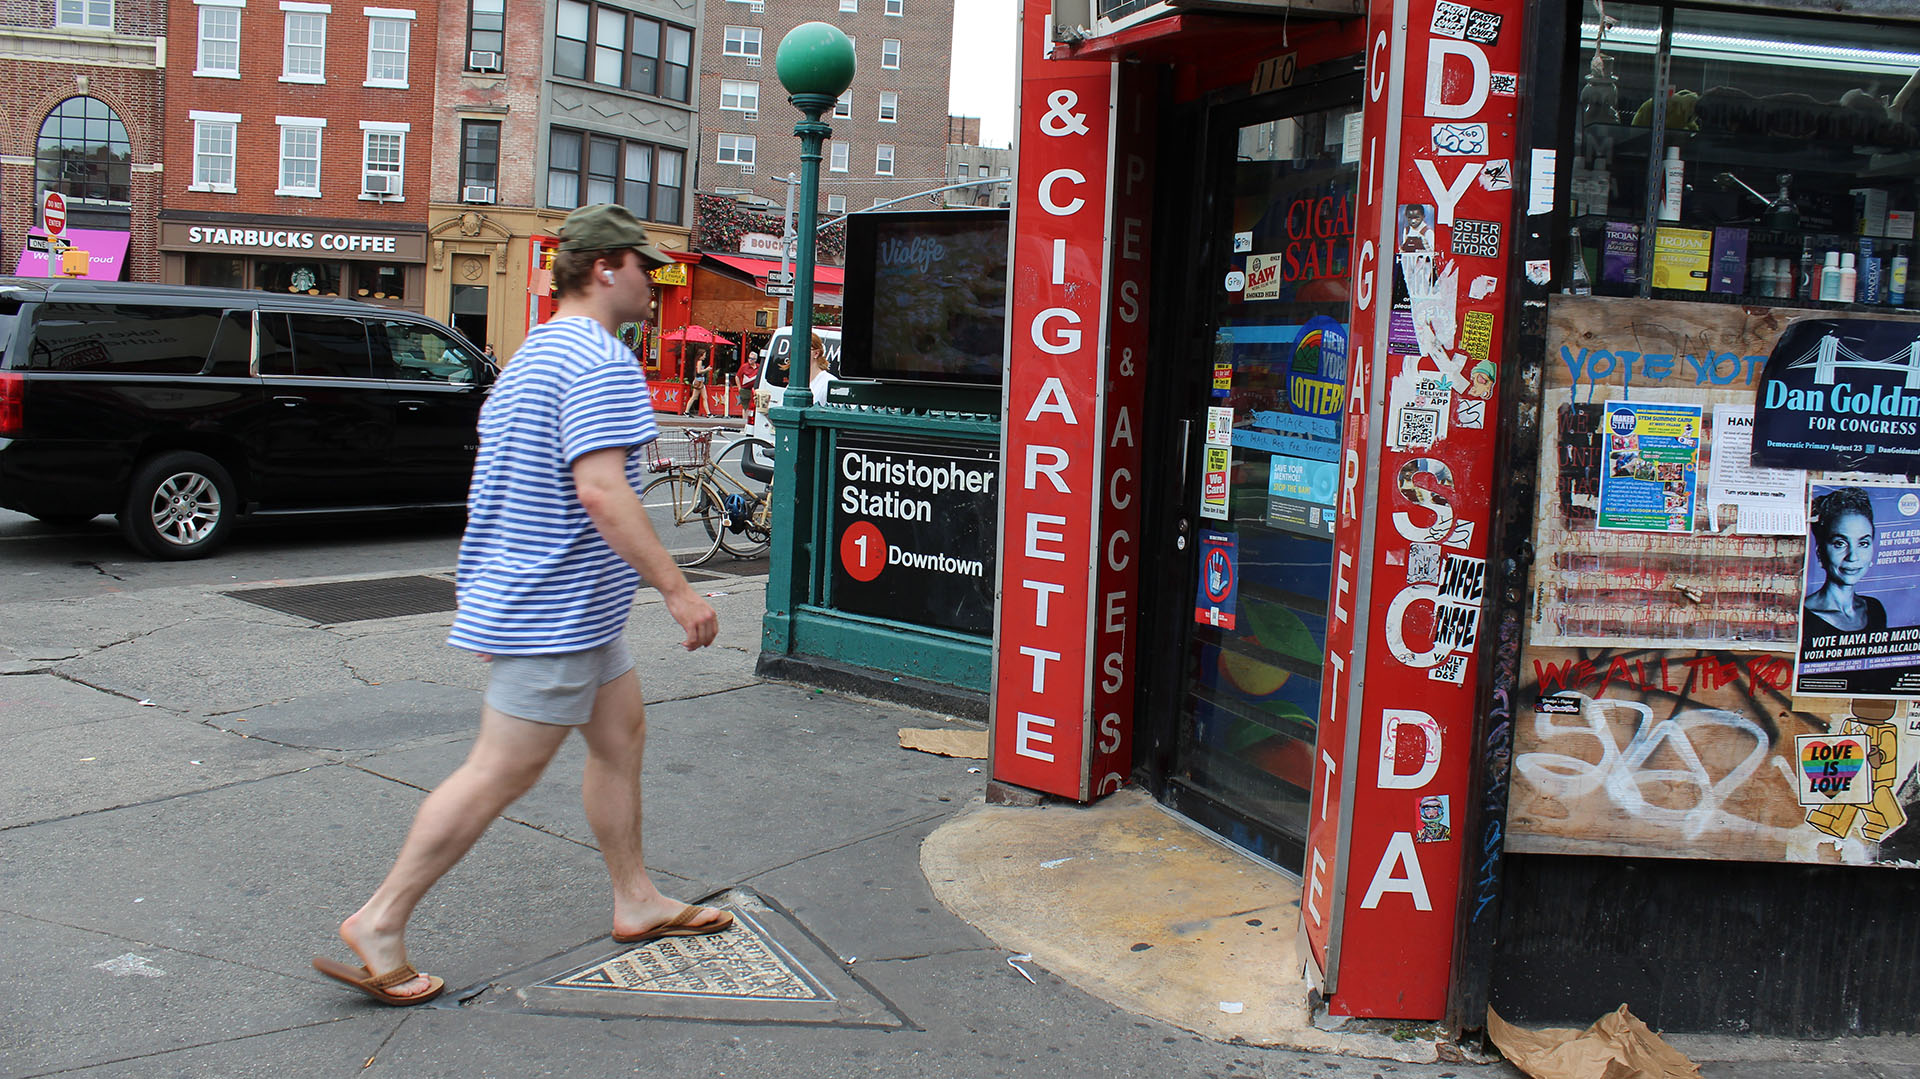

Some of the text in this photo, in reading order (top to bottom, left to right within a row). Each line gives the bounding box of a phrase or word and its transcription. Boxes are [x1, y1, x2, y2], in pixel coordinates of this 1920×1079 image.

[1256, 55, 1295, 92] 110
[49, 218, 62, 228] ENTER
[1287, 195, 1356, 241] CIGA
[1455, 220, 1499, 235] 3STER
[189, 227, 396, 252] STARBUCKS COFFEE
[1454, 232, 1498, 246] ZE5KO
[1606, 231, 1638, 240] TROJAN
[1660, 236, 1703, 248] TROJAN
[881, 237, 945, 273] Violife
[1452, 242, 1497, 256] HYDRO
[89, 256, 114, 264] roud
[1248, 265, 1277, 288] RAW
[1867, 260, 1877, 301] MANDELAY
[1119, 347, 1135, 377] &
[1431, 398, 1448, 406] APP
[1765, 379, 1824, 412] Dan
[1016, 89, 1090, 763] & CIGARETTE
[1612, 414, 1635, 423] MAKER
[1809, 416, 1917, 435] FOR CONGRESS
[1611, 422, 1634, 431] STATE
[1767, 439, 1804, 449] Democratic
[1805, 442, 1830, 452] Primary
[1830, 443, 1852, 452] August
[842, 452, 994, 494] Christopher
[1274, 464, 1304, 474] SAVE YOUR
[1209, 473, 1223, 484] We
[1306, 31, 1387, 927] CIGARETTE
[1206, 483, 1225, 495] Card
[1273, 483, 1287, 492] STOP
[1288, 485, 1297, 493] THE
[841, 486, 931, 522] Station
[1894, 538, 1911, 546] YORK,
[854, 535, 983, 577] 1 Downtown
[1878, 549, 1905, 557] PODEMOS
[1877, 557, 1897, 565] NUEVA
[1812, 635, 1837, 648] VOTE
[1839, 633, 1867, 646] MAYA
[1869, 631, 1889, 643] FOR
[1804, 650, 1824, 660] VOTA
[1826, 649, 1842, 658] POR
[1844, 647, 1866, 657] MAYA
[1867, 645, 1887, 655] PARA
[1434, 670, 1456, 680] D65
[1811, 745, 1852, 760] LOVE
[1823, 761, 1839, 776] IS
[1810, 777, 1852, 792] LOVE
